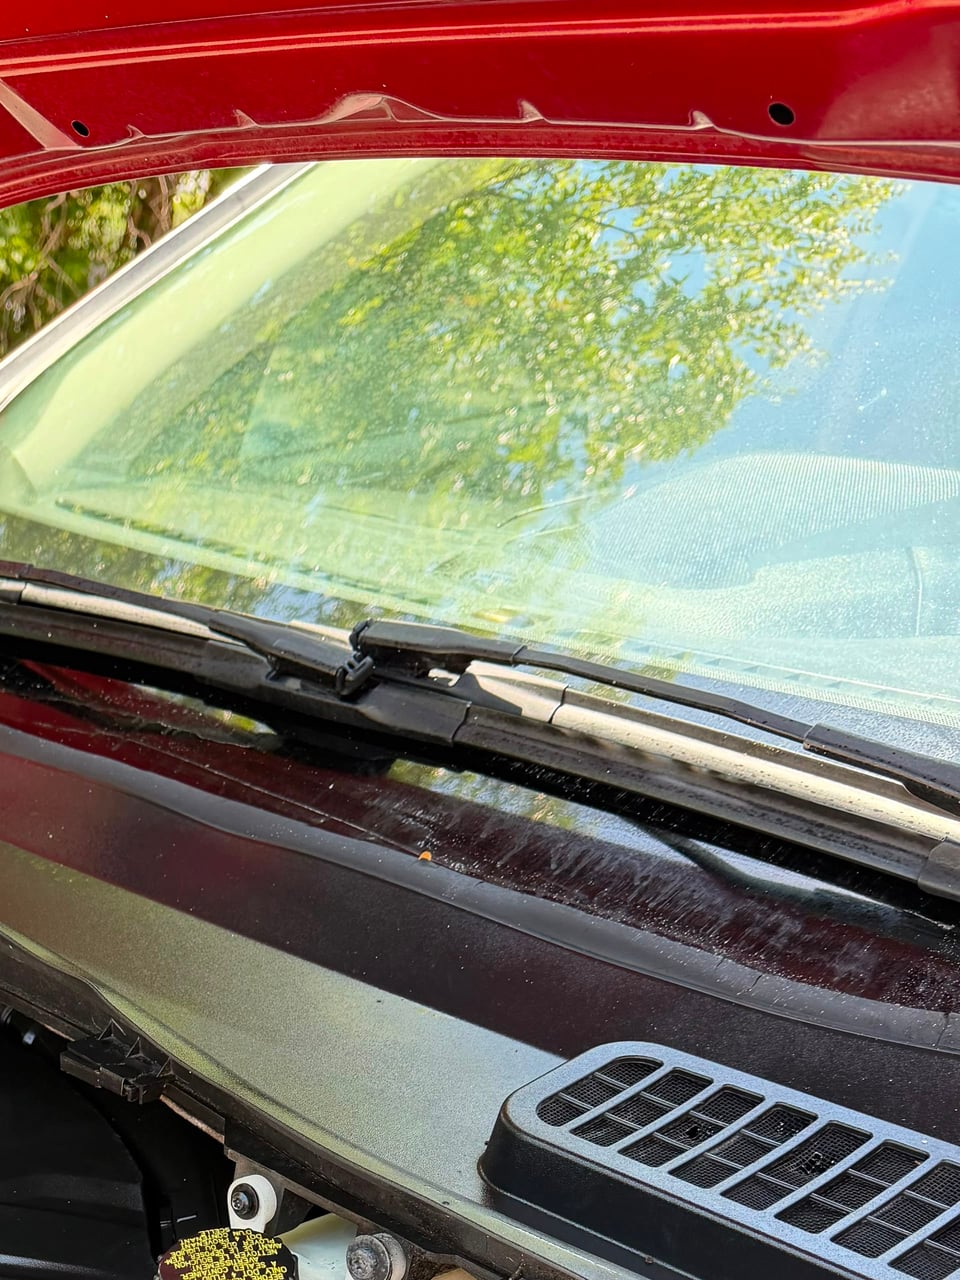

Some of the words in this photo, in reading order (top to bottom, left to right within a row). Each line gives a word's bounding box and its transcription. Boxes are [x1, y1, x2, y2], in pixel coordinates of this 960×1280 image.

[180, 1238, 228, 1249] PROVENANT
[242, 1238, 274, 1246] PLOYER
[234, 1248, 277, 1258] NETTOYER
[174, 1257, 212, 1269] BOUCHON
[233, 1262, 266, 1270] SEALED
[265, 1266, 287, 1274] ONLY
[252, 1273, 284, 1280] BEFORE
